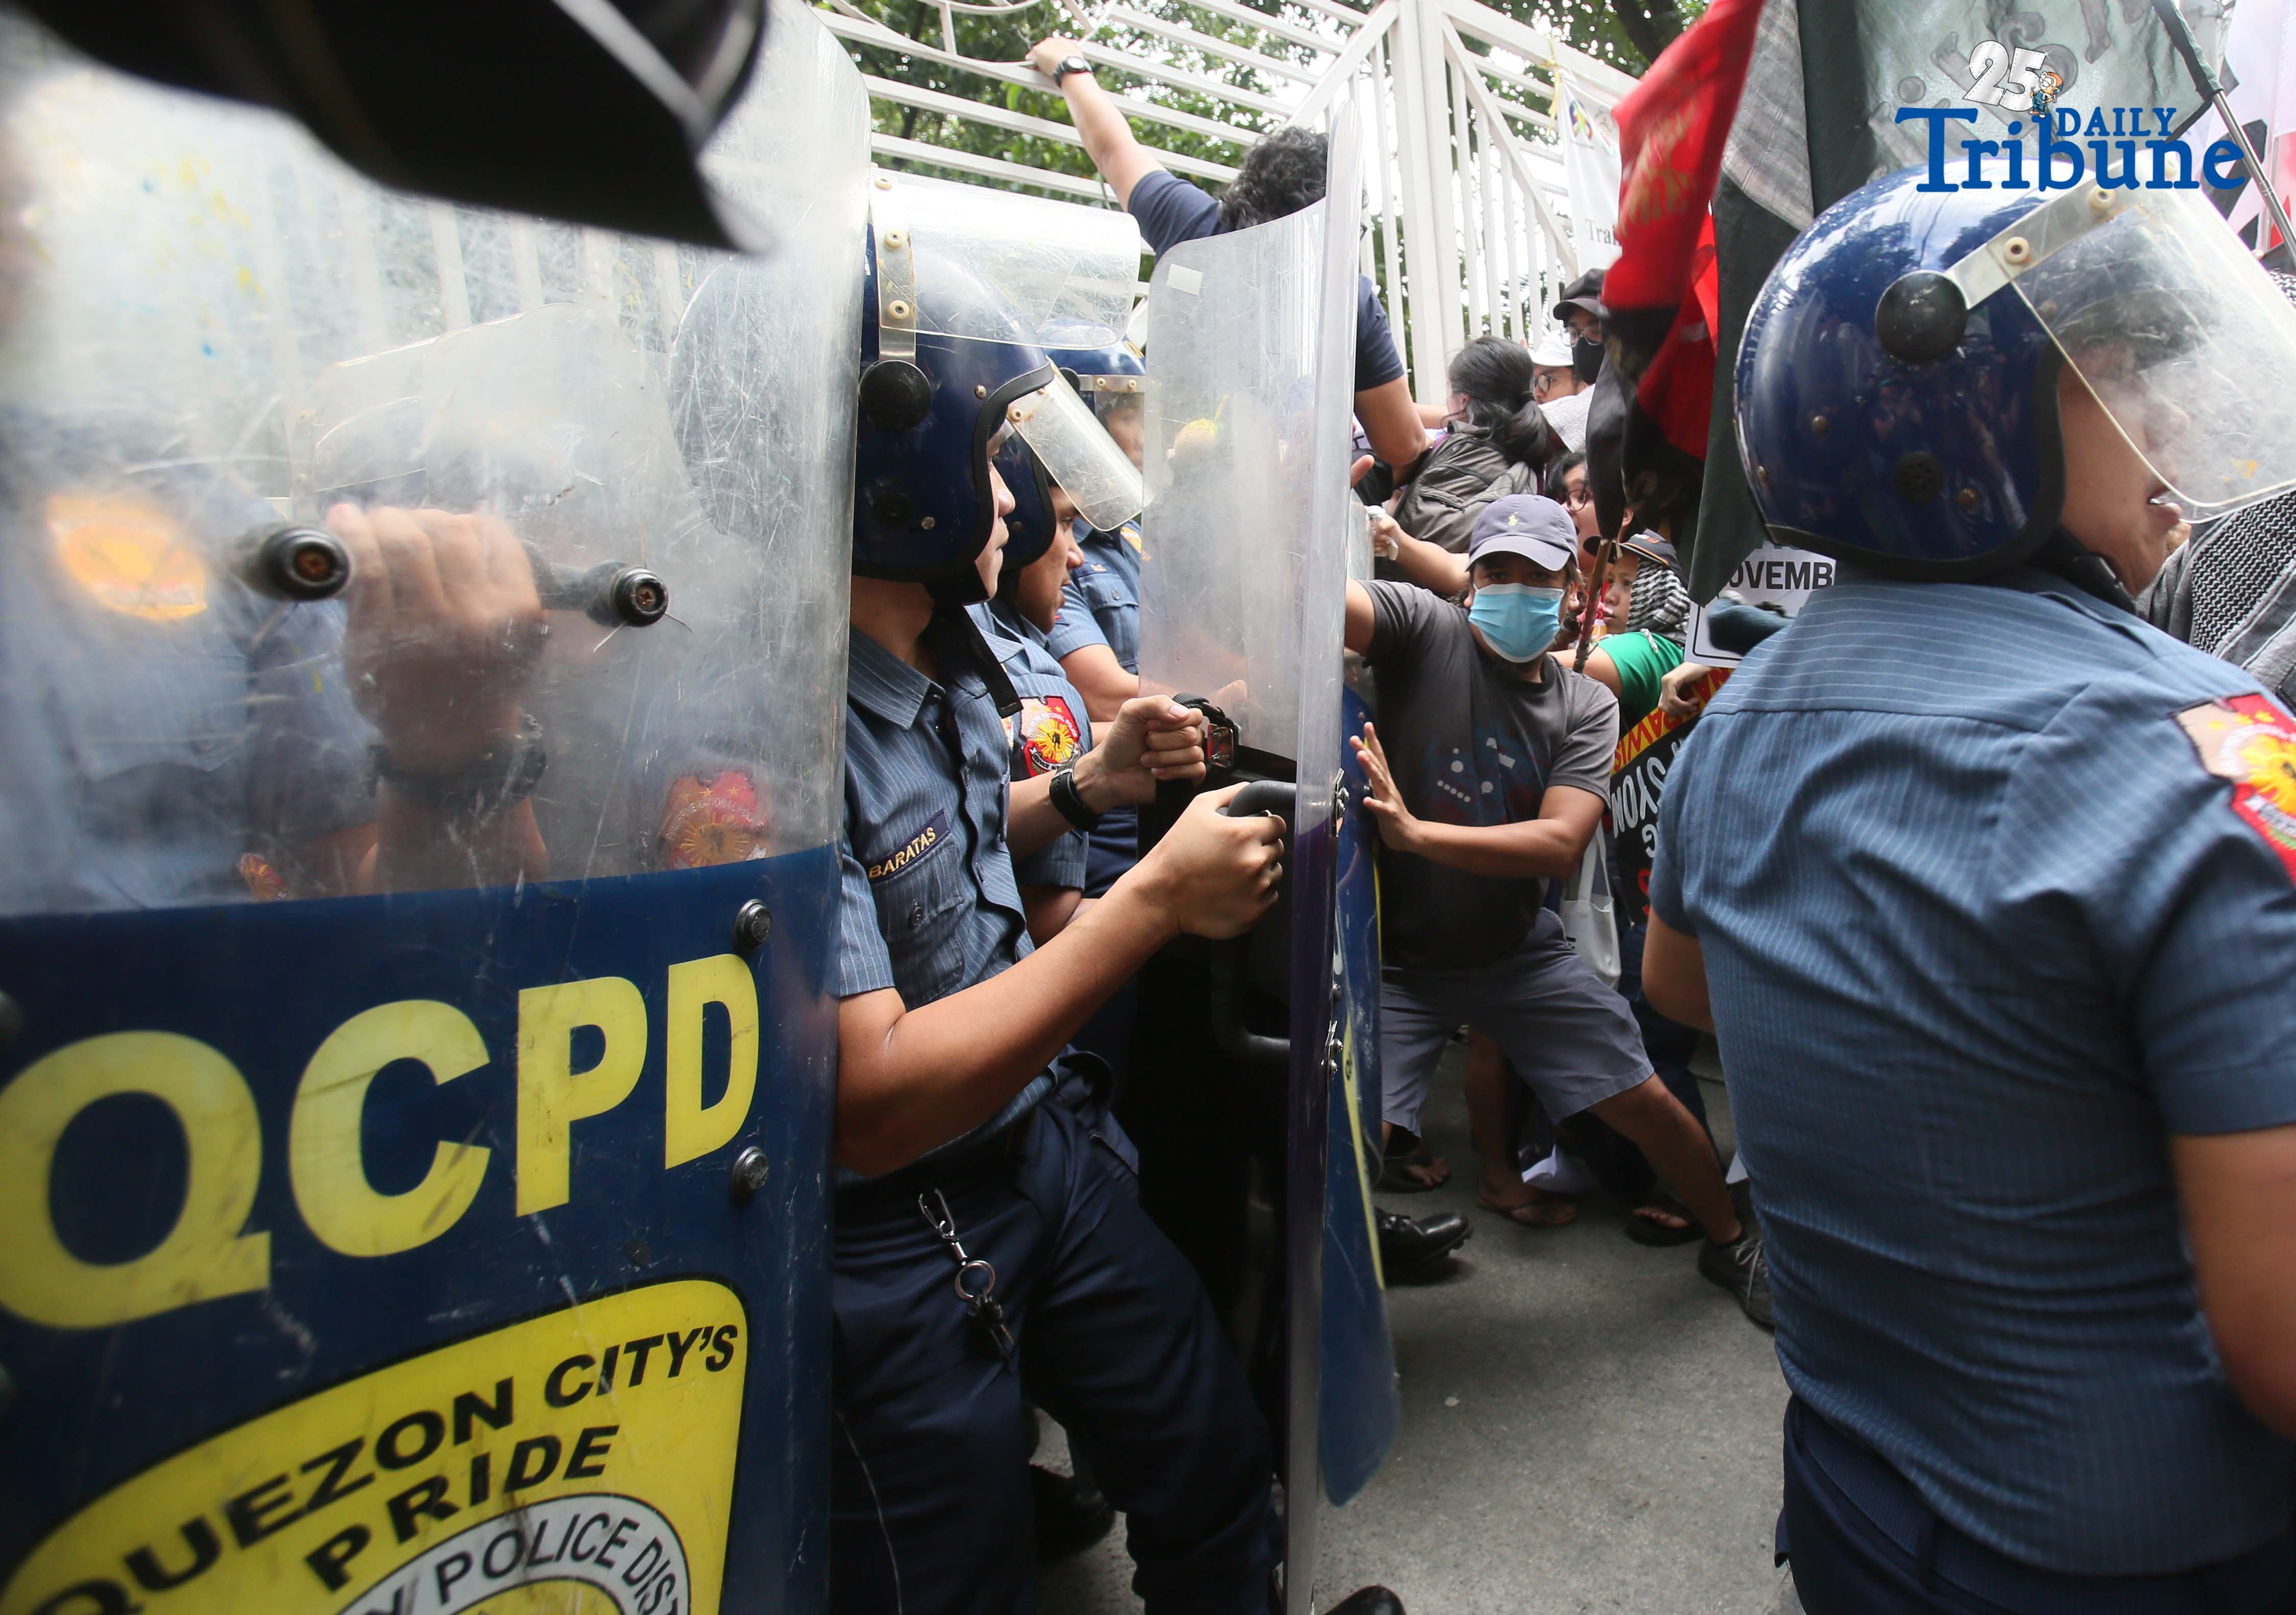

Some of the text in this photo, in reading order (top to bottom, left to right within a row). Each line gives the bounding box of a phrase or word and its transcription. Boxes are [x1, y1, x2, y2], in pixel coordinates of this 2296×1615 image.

[1585, 218, 1622, 246] Trai
[869, 827, 936, 879] BARATAS
[0, 953, 759, 1330] QCPD
[544, 1324, 738, 1408] CITY'S
[303, 1425, 620, 1593] PRIDE
[435, 1513, 639, 1604] POLICE
